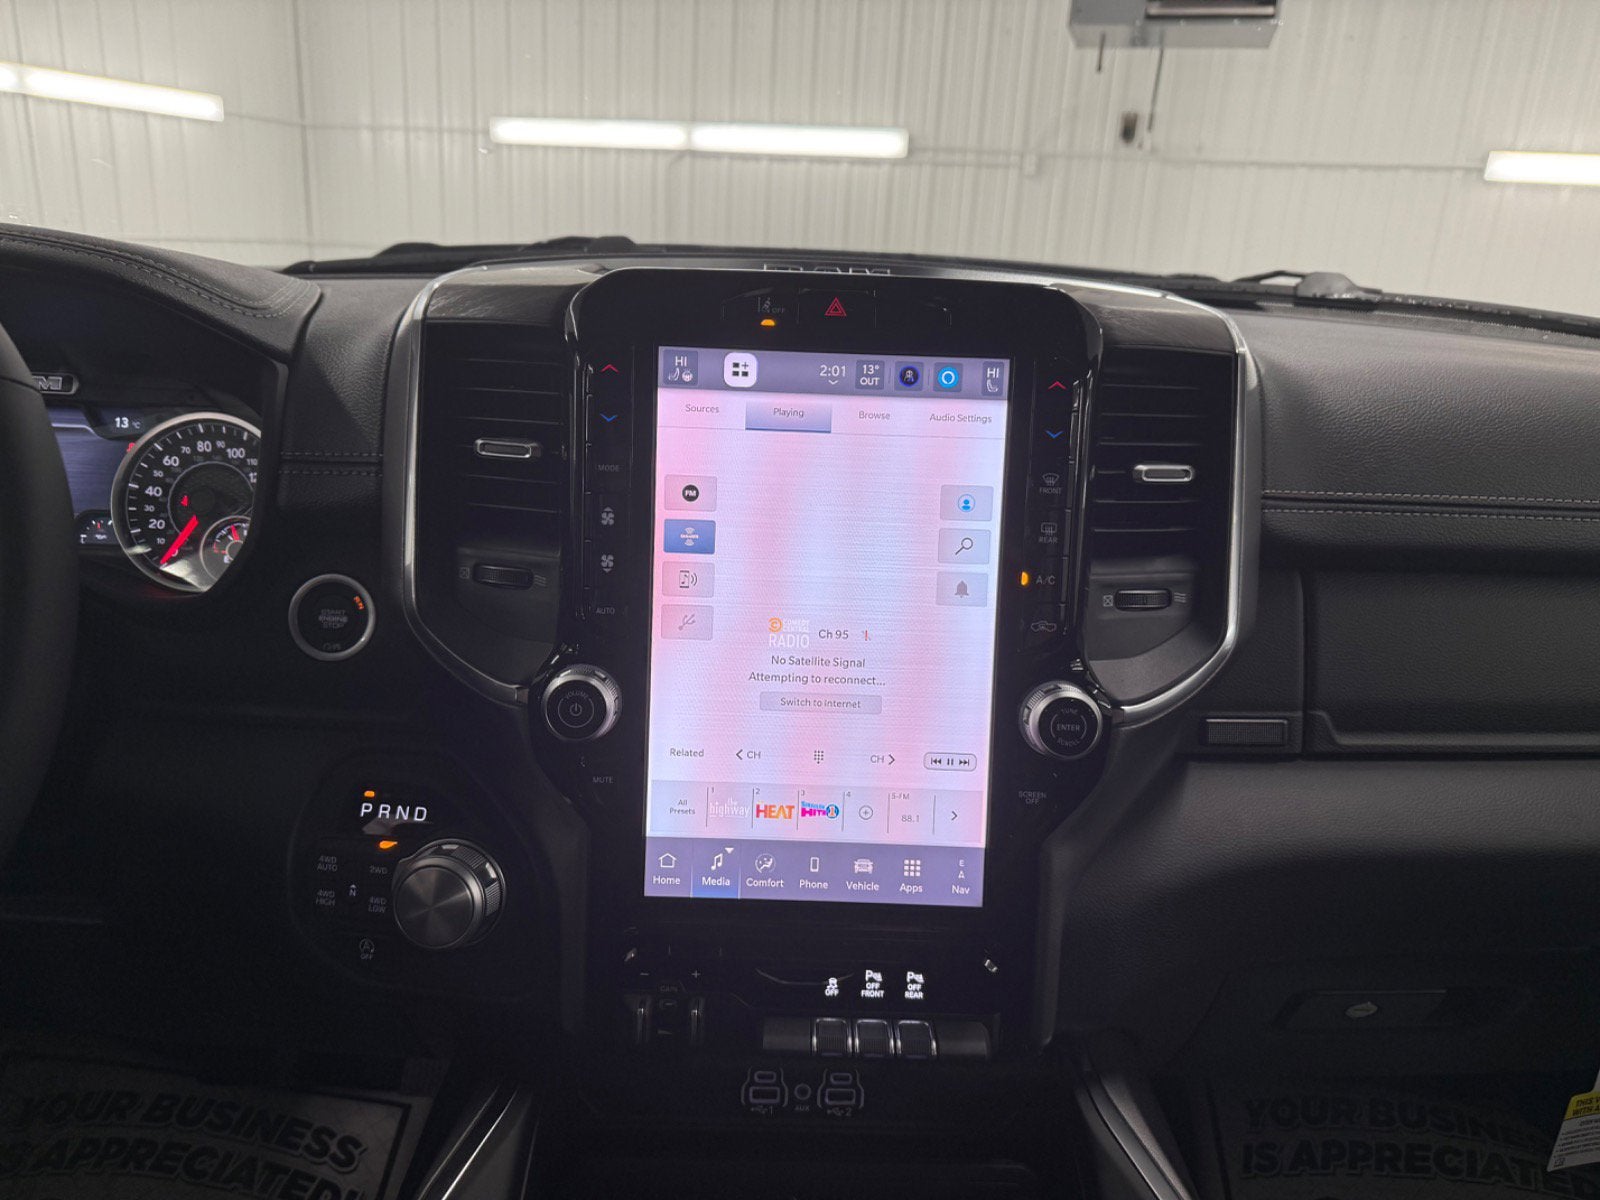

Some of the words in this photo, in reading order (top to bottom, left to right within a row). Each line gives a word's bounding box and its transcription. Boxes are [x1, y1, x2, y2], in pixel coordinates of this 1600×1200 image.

[674, 356, 688, 367] HI
[819, 364, 846, 377] 2:01
[862, 364, 880, 375] 13°
[986, 367, 999, 378] HI
[860, 376, 880, 386] OUT
[685, 404, 720, 414] Sources
[773, 407, 804, 418] Playing
[858, 410, 890, 420] Browse
[930, 413, 955, 422] Audio
[957, 414, 992, 424] Settings
[114, 416, 130, 428] 13
[196, 440, 212, 452] 80
[216, 440, 226, 448] 90
[180, 446, 191, 454] 70
[226, 448, 246, 458] 100
[162, 455, 180, 467] 60
[246, 458, 258, 466] 110
[598, 464, 620, 472] MODE
[152, 470, 164, 478] 50
[144, 486, 162, 498] 40
[1040, 486, 1062, 494] FRONT
[144, 504, 156, 512] 30
[148, 518, 166, 530] 20
[156, 537, 166, 545] 10
[1036, 576, 1056, 585] A/C
[596, 607, 616, 615] AUTO
[818, 629, 833, 640] Ch
[835, 630, 849, 640] 95
[768, 634, 810, 648] RADIO
[771, 655, 786, 665] No
[788, 655, 831, 667] Satellite
[832, 657, 866, 670] Signal
[748, 672, 809, 686] Attempting
[810, 674, 821, 684] to
[824, 676, 886, 686] reconnect...
[780, 696, 810, 707] Switch
[812, 698, 822, 707] to
[824, 699, 862, 709] Internet
[1056, 724, 1080, 732] ENTER
[669, 748, 704, 758] Related
[746, 750, 762, 760] CH
[870, 754, 885, 764] CH
[1018, 790, 1047, 799] SCREEN
[669, 807, 696, 815] Presets
[709, 802, 750, 818] highway
[755, 804, 796, 819] HEAT
[901, 815, 920, 823] 88.1
[318, 856, 337, 864] 4WD
[316, 864, 338, 872] AUTO
[369, 865, 388, 874] 2WD
[652, 876, 681, 885] Home
[702, 876, 730, 886] Media
[746, 878, 784, 888] Comfort
[800, 879, 829, 890] Phone
[846, 882, 880, 891] Vehicle
[900, 883, 923, 894] Apps
[952, 885, 970, 894] Nav
[317, 890, 335, 898] 4WD
[316, 898, 336, 906] HIGH
[824, 988, 839, 996] OFF
[860, 990, 884, 998] FRONT
[904, 990, 924, 1000] REAR
[1245, 1097, 1361, 1131] YOUR
[18, 1090, 141, 1128] YOUR
[141, 1093, 365, 1169] BUSINESS
[1241, 1142, 1281, 1176] IS
